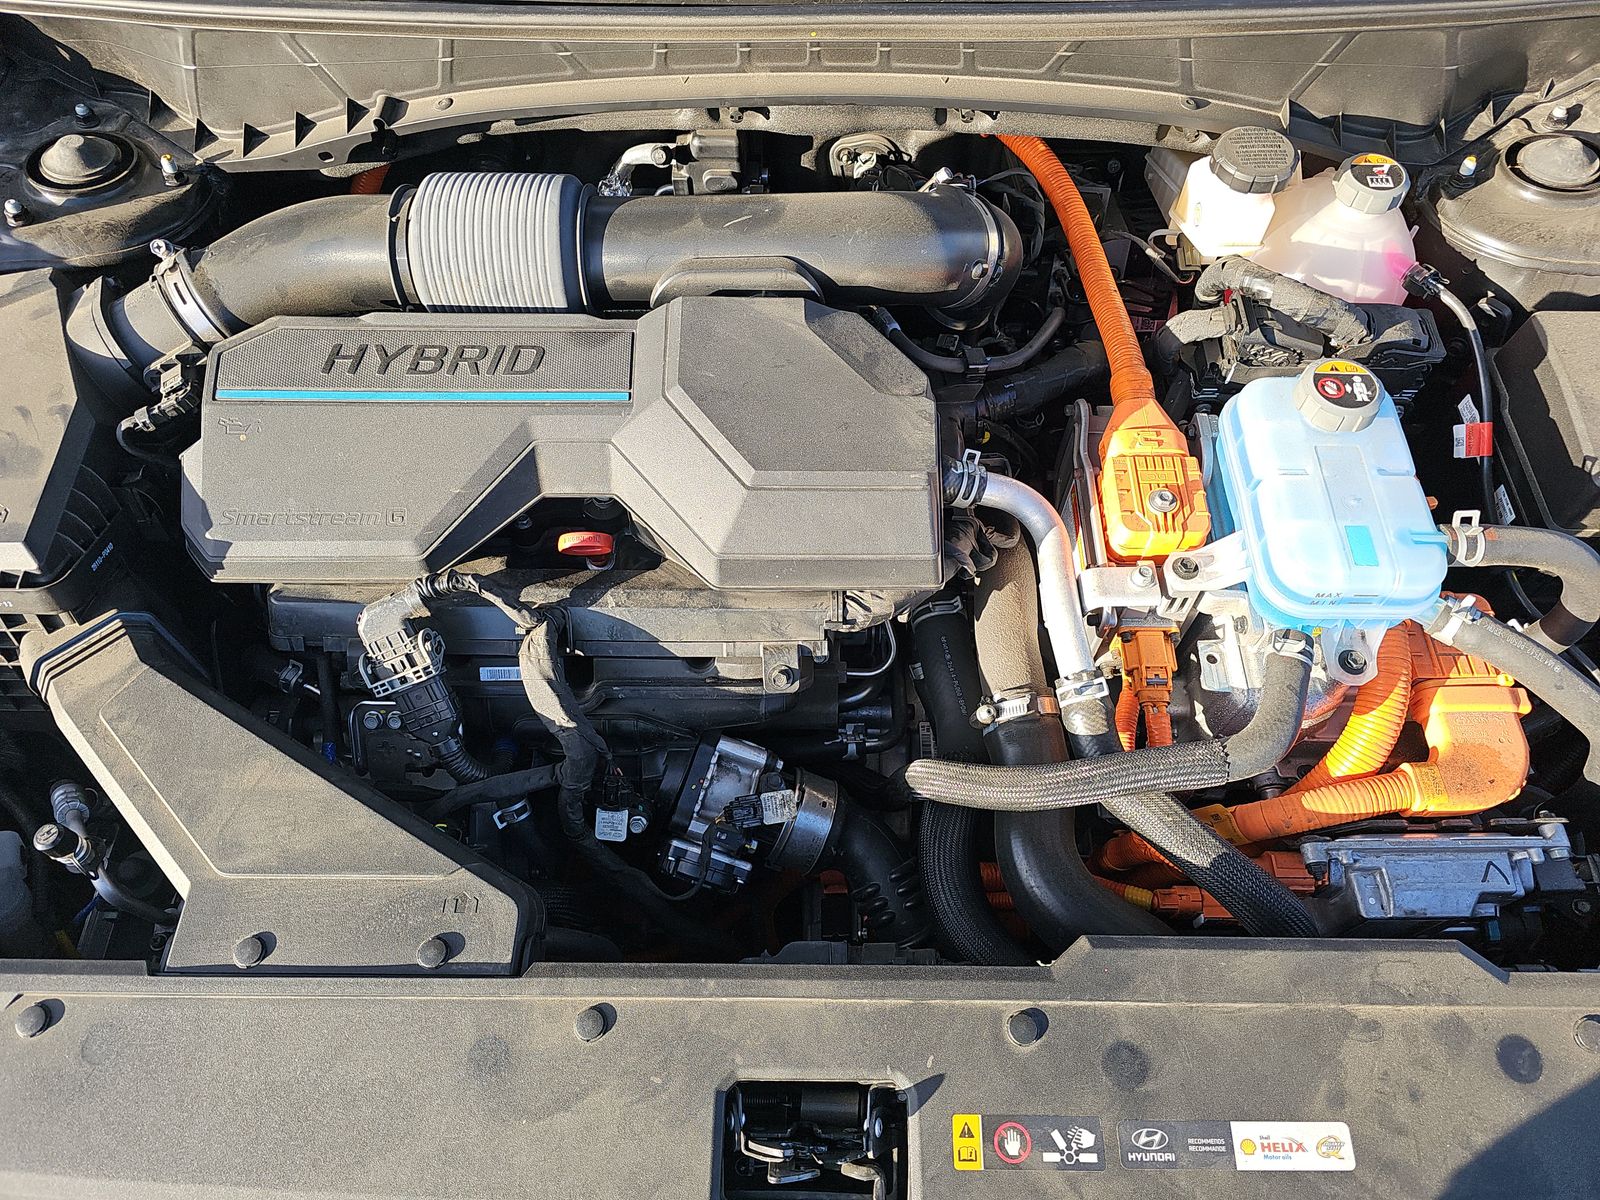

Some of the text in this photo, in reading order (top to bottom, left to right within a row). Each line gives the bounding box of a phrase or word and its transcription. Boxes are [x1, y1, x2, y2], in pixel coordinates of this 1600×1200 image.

[320, 343, 545, 376] HYBRID
[220, 508, 406, 526] Smartstream G
[1260, 1142, 1306, 1152] HELIX
[1128, 1152, 1176, 1162] HYUNDAI
